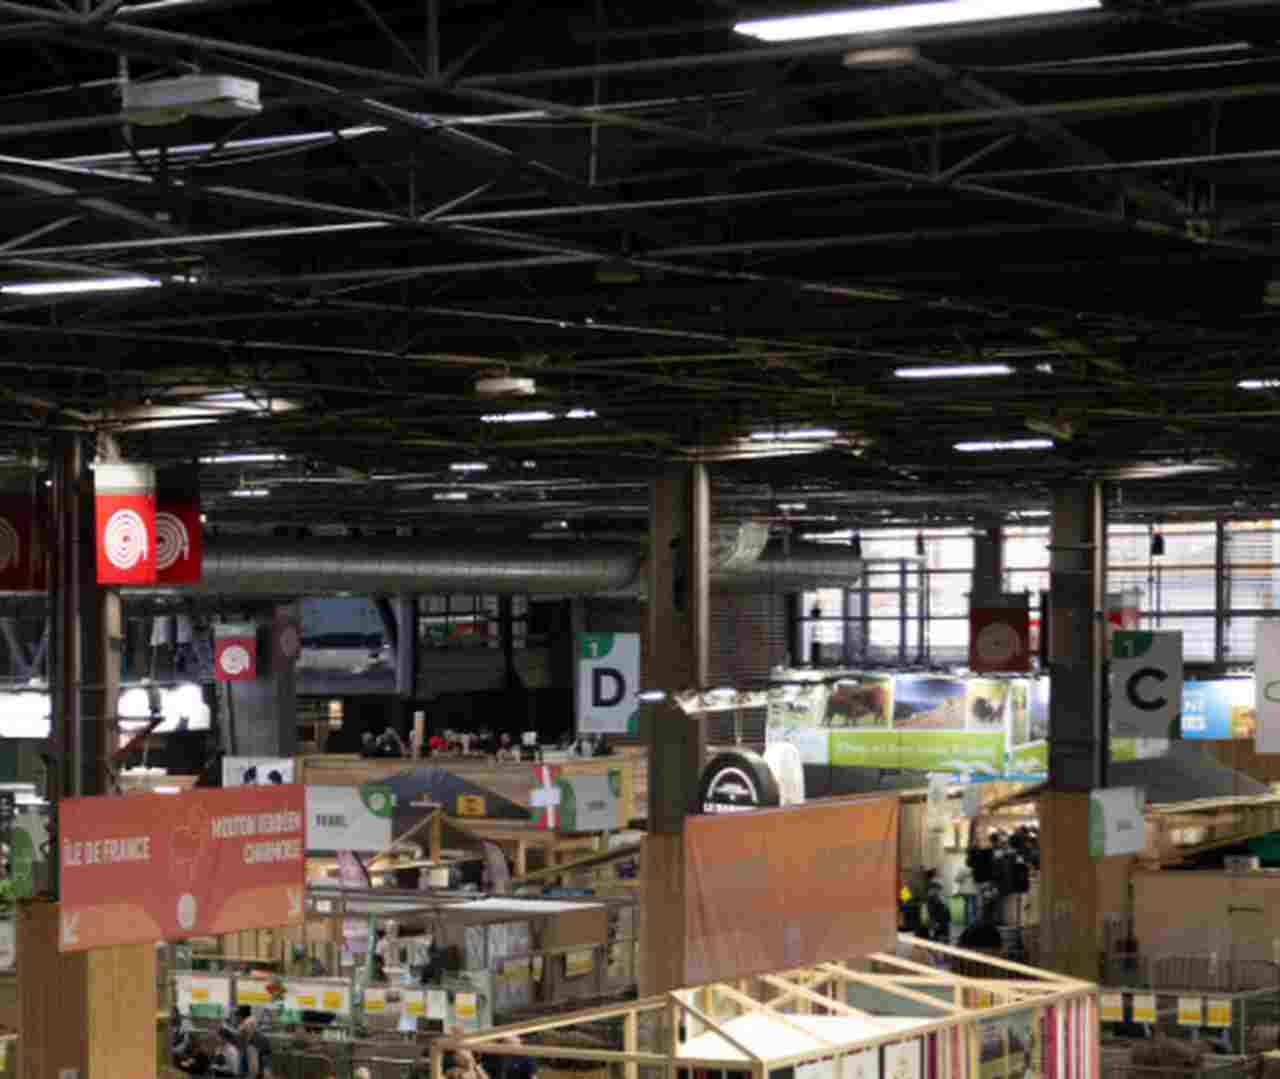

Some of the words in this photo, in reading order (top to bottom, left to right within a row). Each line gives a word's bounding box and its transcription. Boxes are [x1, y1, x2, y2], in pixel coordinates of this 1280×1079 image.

[592, 668, 627, 707] D
[1126, 668, 1168, 711] C
[64, 837, 82, 865] ÎLE
[85, 839, 101, 864] DE
[103, 836, 150, 863] FRANCE
